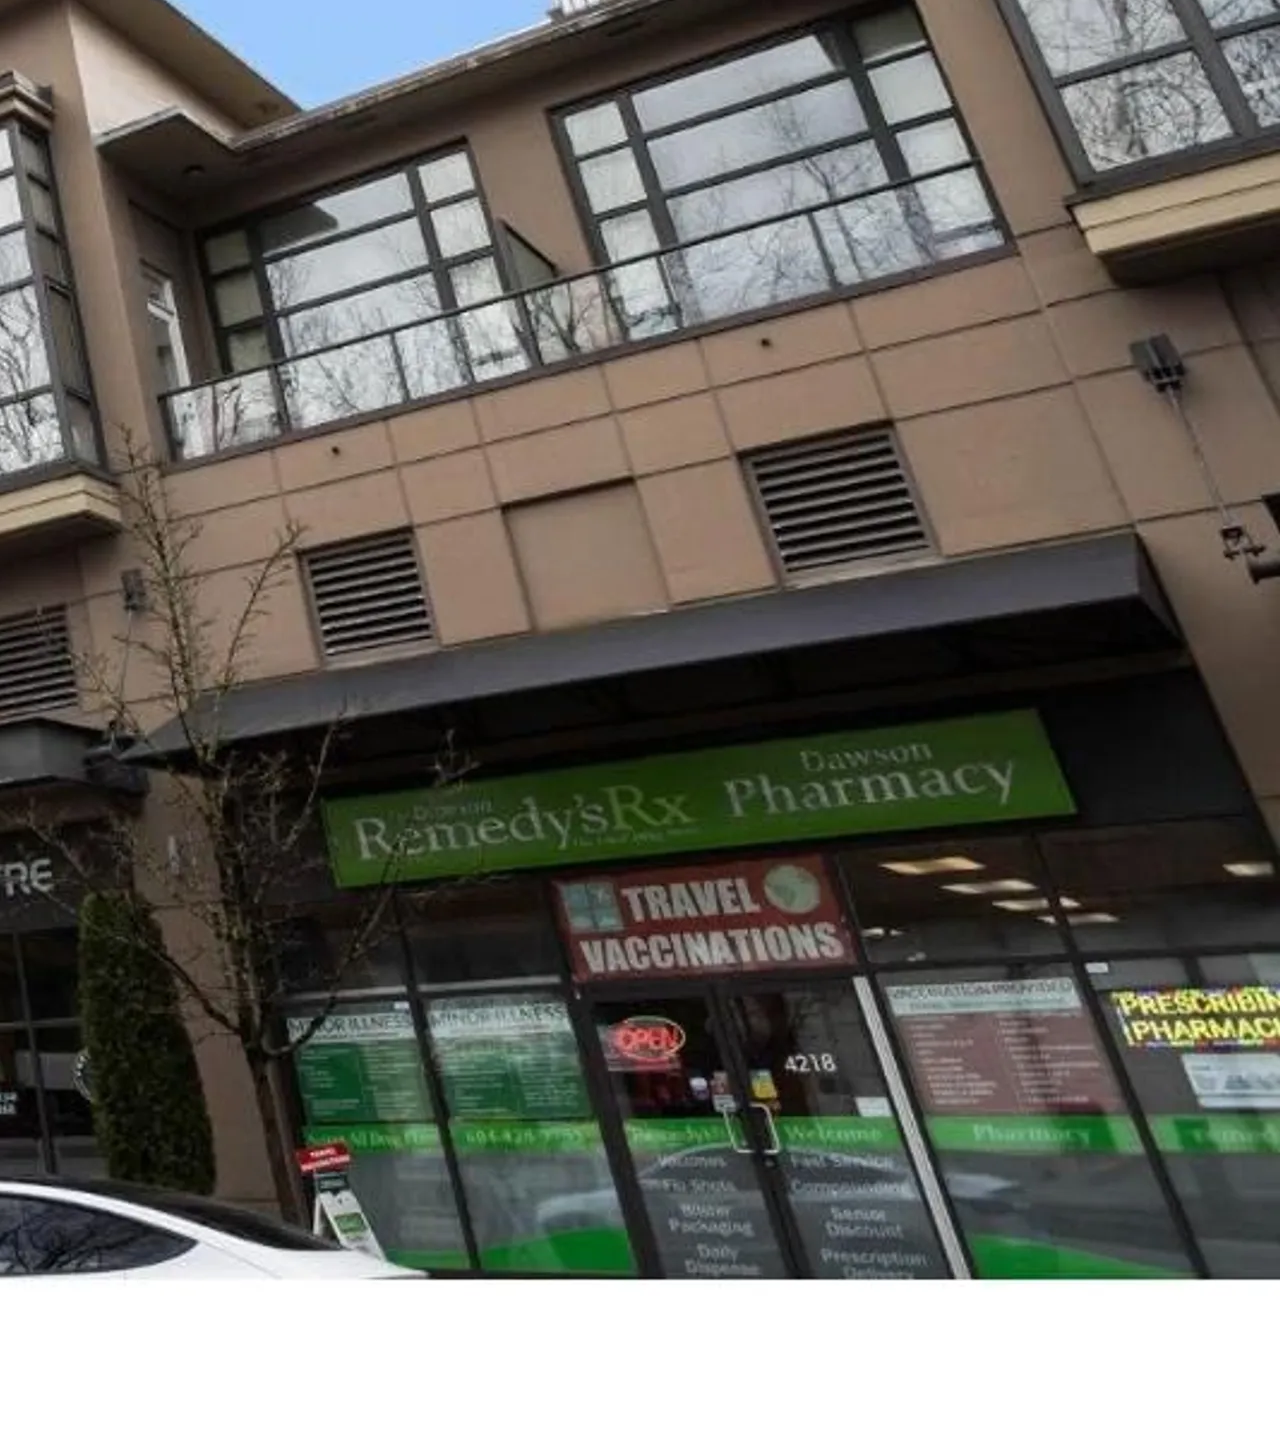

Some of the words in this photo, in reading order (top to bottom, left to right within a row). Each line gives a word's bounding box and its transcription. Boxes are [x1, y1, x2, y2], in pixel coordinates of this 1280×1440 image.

[801, 742, 933, 772] Dawson
[724, 759, 1015, 817] Pharmacy
[620, 877, 763, 922] TRAVEL
[580, 921, 845, 973] VACCINATIONS
[784, 1054, 837, 1073] 4218
[783, 1123, 883, 1142] Welcome
